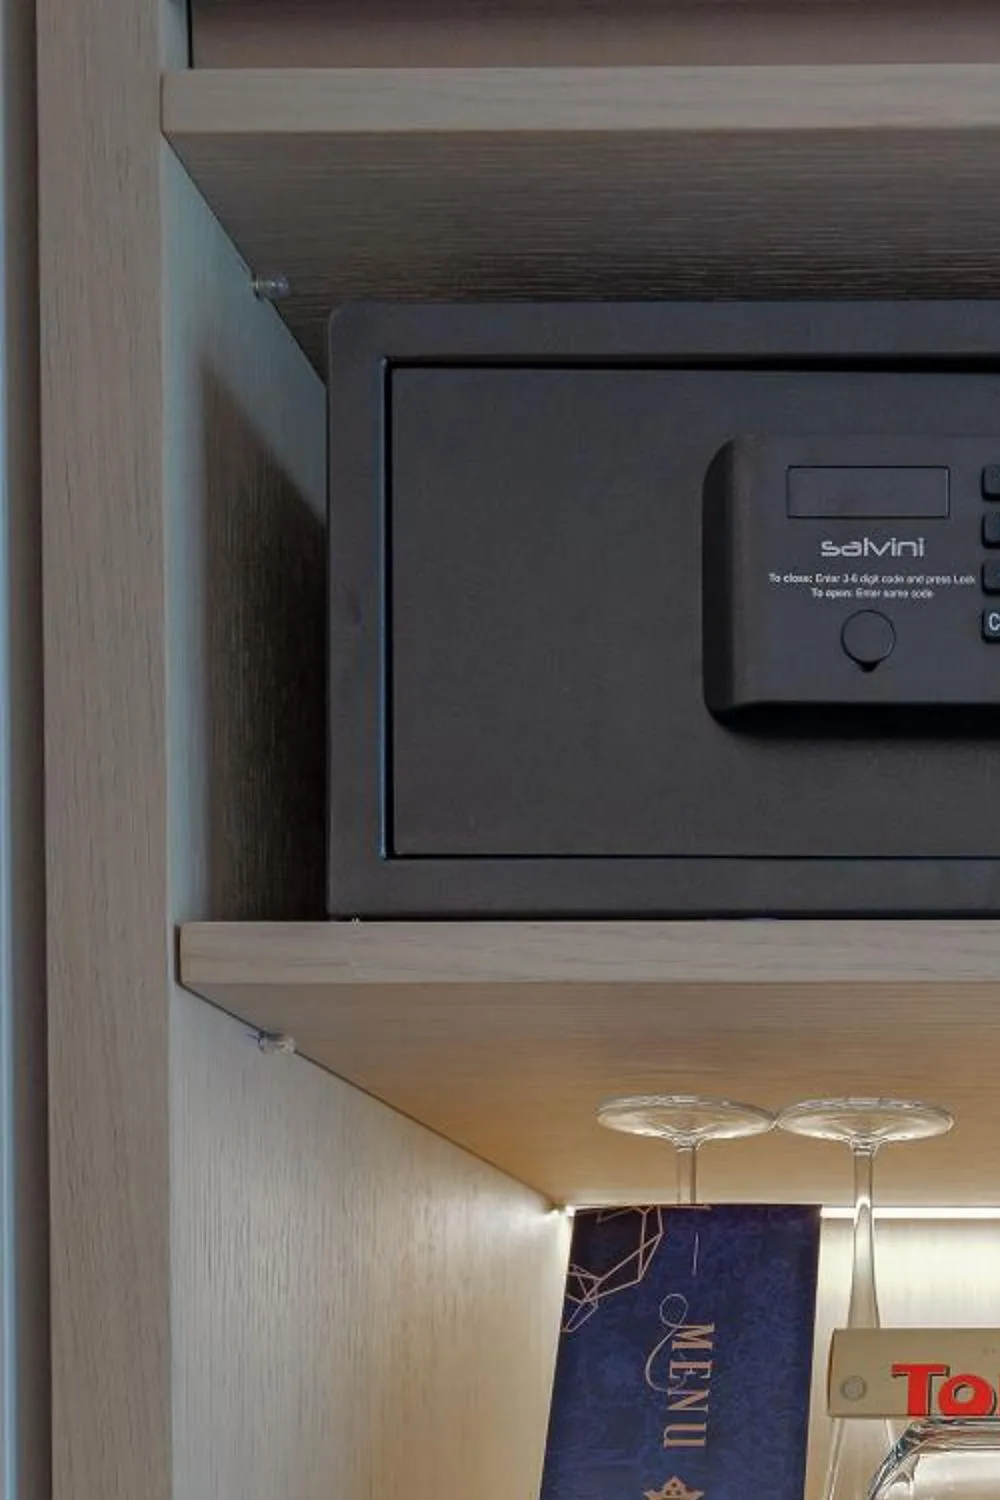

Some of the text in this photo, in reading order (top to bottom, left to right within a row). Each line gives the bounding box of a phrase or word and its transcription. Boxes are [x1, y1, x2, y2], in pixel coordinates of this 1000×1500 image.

[821, 537, 925, 557] salvini
[769, 574, 780, 583] To
[815, 573, 841, 583] Enter
[860, 573, 879, 585] digit
[881, 573, 904, 583] code
[907, 574, 924, 583] and
[925, 575, 951, 585] press
[953, 574, 976, 584] Lock
[812, 588, 823, 598] To
[855, 588, 880, 598] Enter
[883, 589, 909, 598] same
[911, 589, 934, 598] code
[664, 1322, 715, 1449] MENU
